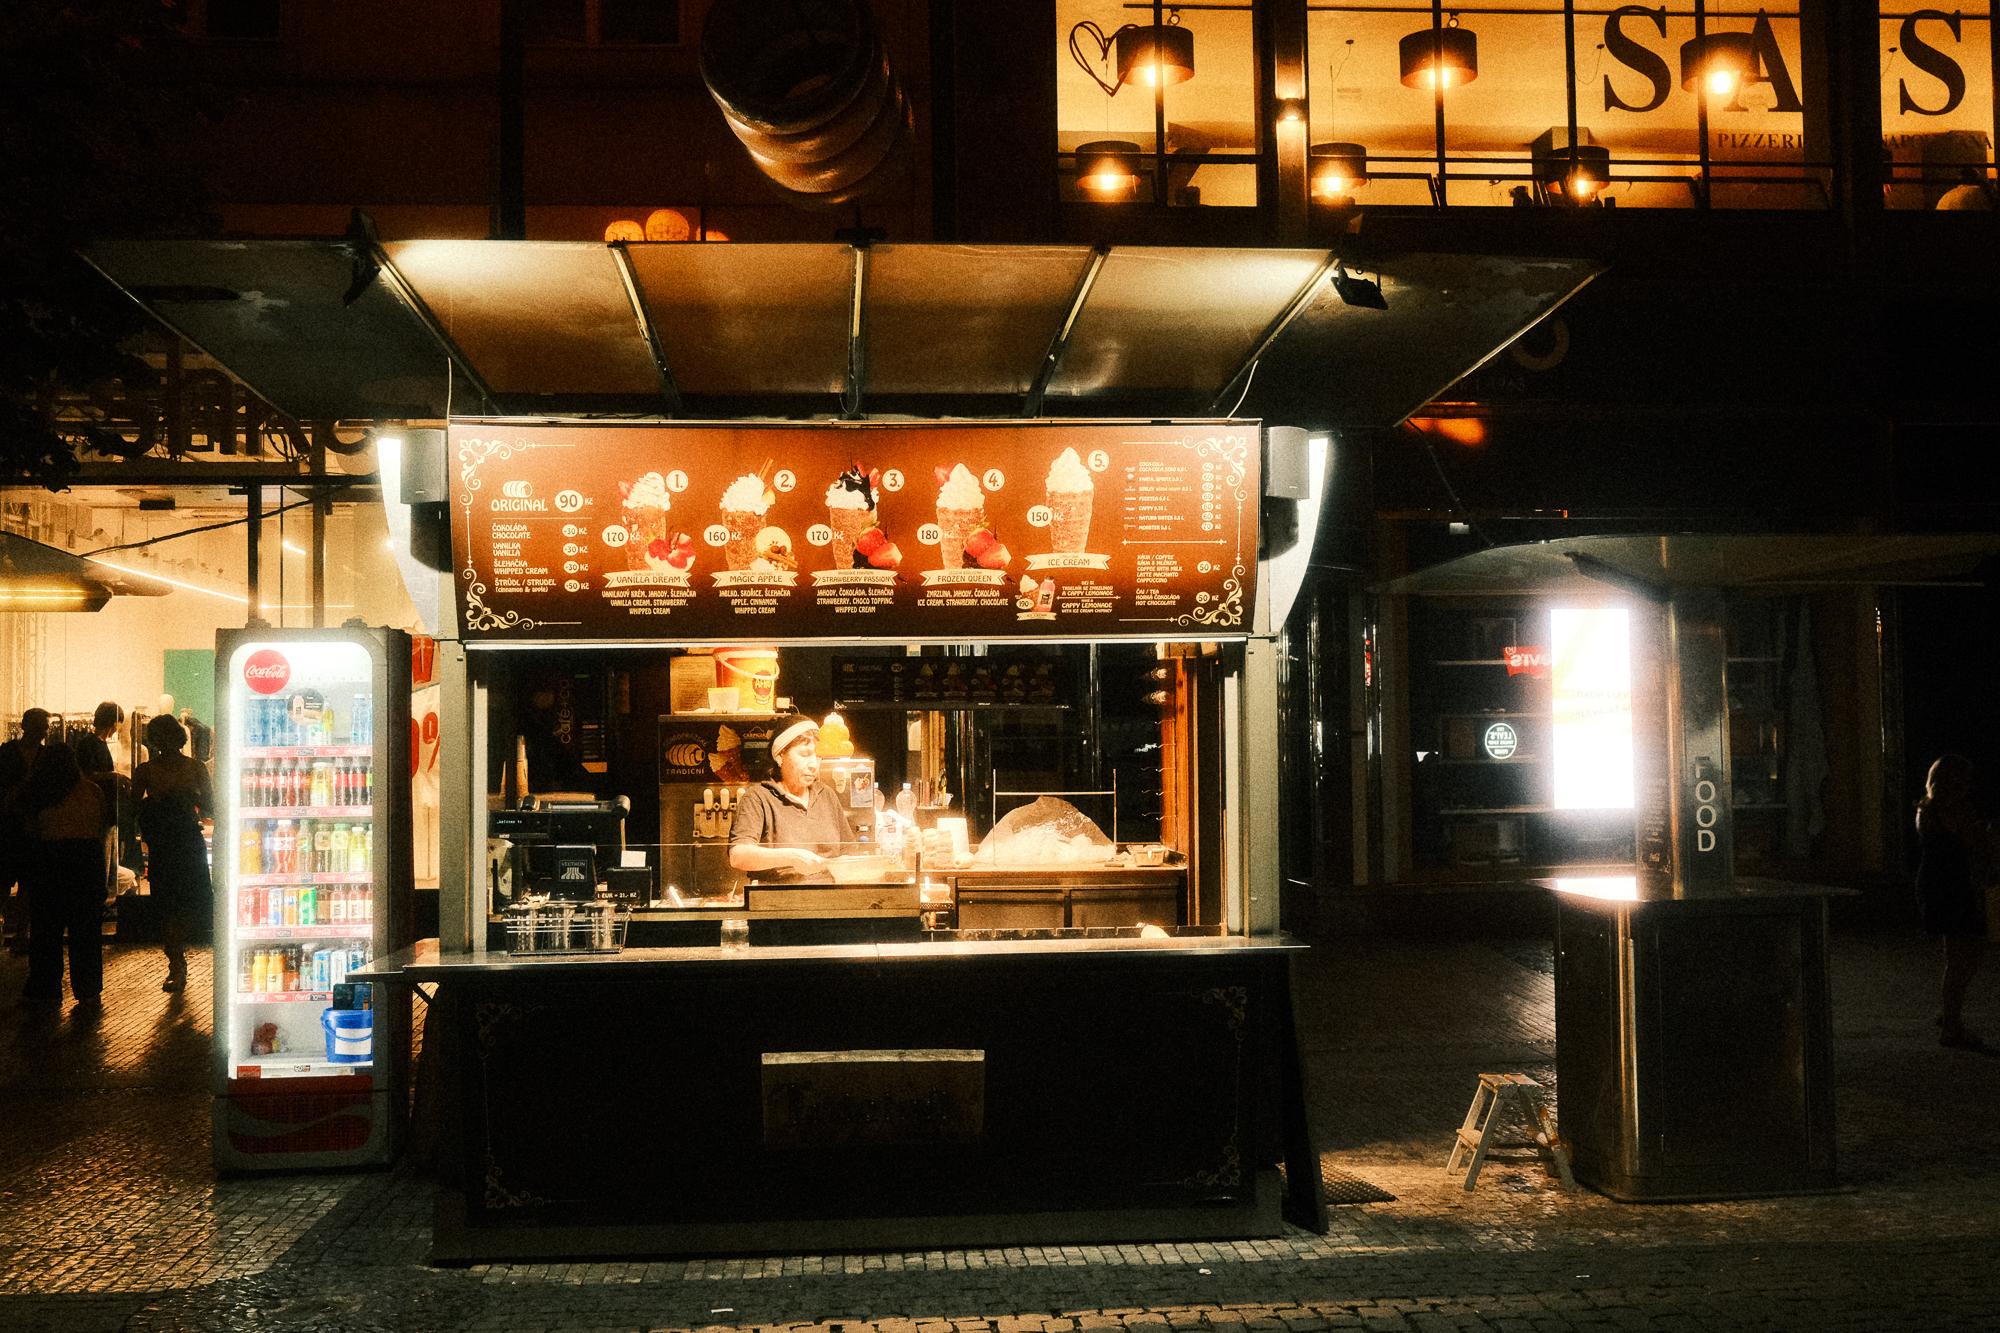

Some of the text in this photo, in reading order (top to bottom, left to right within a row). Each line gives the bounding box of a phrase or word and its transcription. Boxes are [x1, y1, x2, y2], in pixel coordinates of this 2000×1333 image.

[1717, 133, 1804, 149] PIZZERI
[1094, 454, 1105, 468] 5.
[675, 474, 683, 488] 1.
[780, 474, 792, 488] 2.
[890, 473, 900, 488] 3.
[988, 472, 1000, 487] 4.
[490, 499, 548, 511] ORIGINAL
[559, 495, 578, 508] 90
[1032, 512, 1048, 521] 150
[492, 523, 527, 531] ČOKOLÁDA
[606, 532, 624, 542] 170
[709, 531, 726, 541] 160
[811, 531, 829, 540] 170
[921, 530, 938, 540] 180
[246, 664, 287, 679] Coca-Cola
[1695, 756, 1717, 852] FOOD
